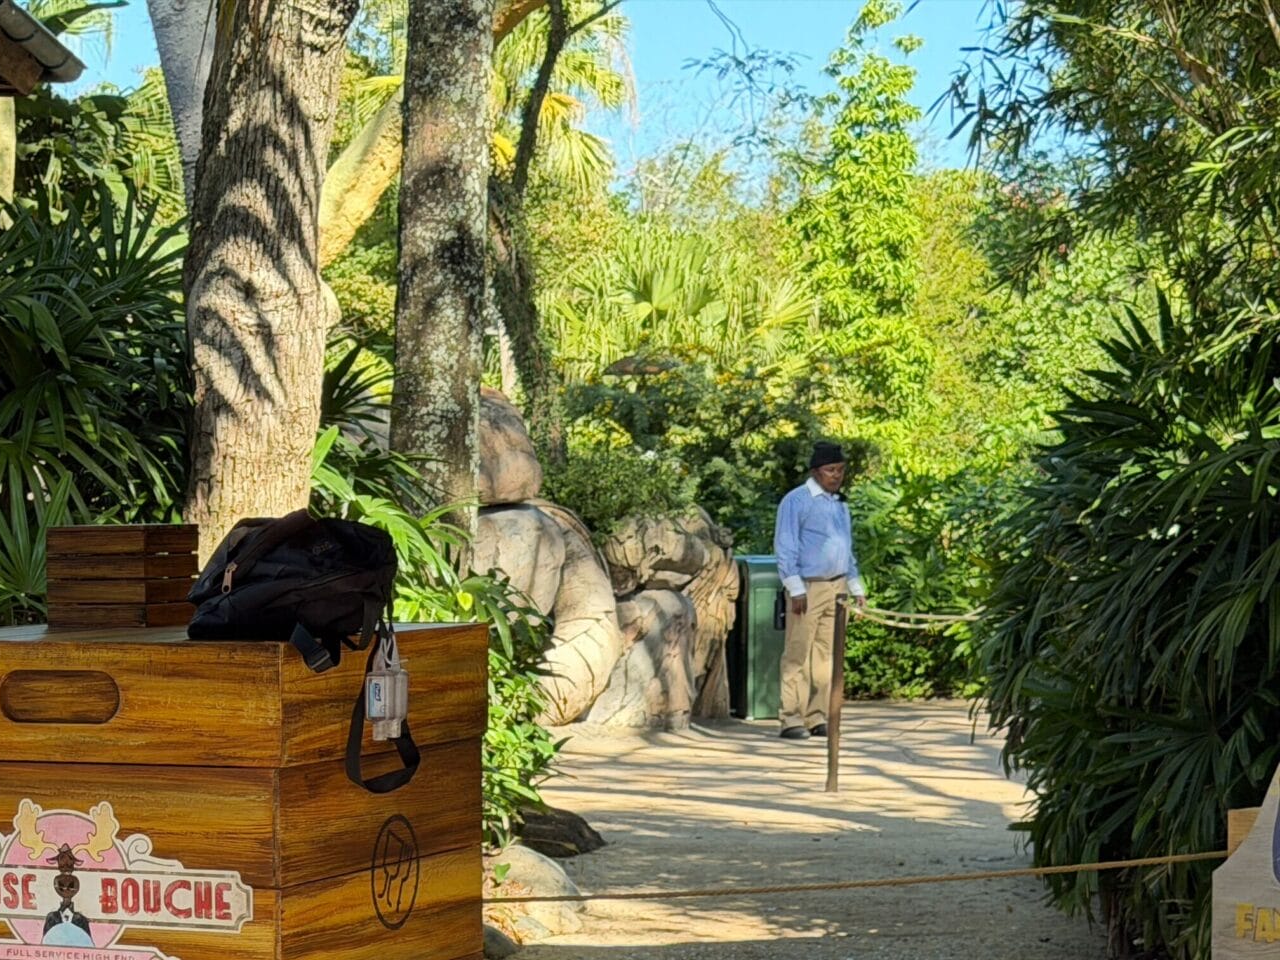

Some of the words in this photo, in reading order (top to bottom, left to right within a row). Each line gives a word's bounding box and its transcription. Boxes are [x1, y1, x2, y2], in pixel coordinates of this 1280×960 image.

[99, 877, 232, 921] BOUCHE
[6, 948, 32, 957] FULL
[34, 950, 81, 960] SERVICE
[83, 952, 110, 960] HIGH
